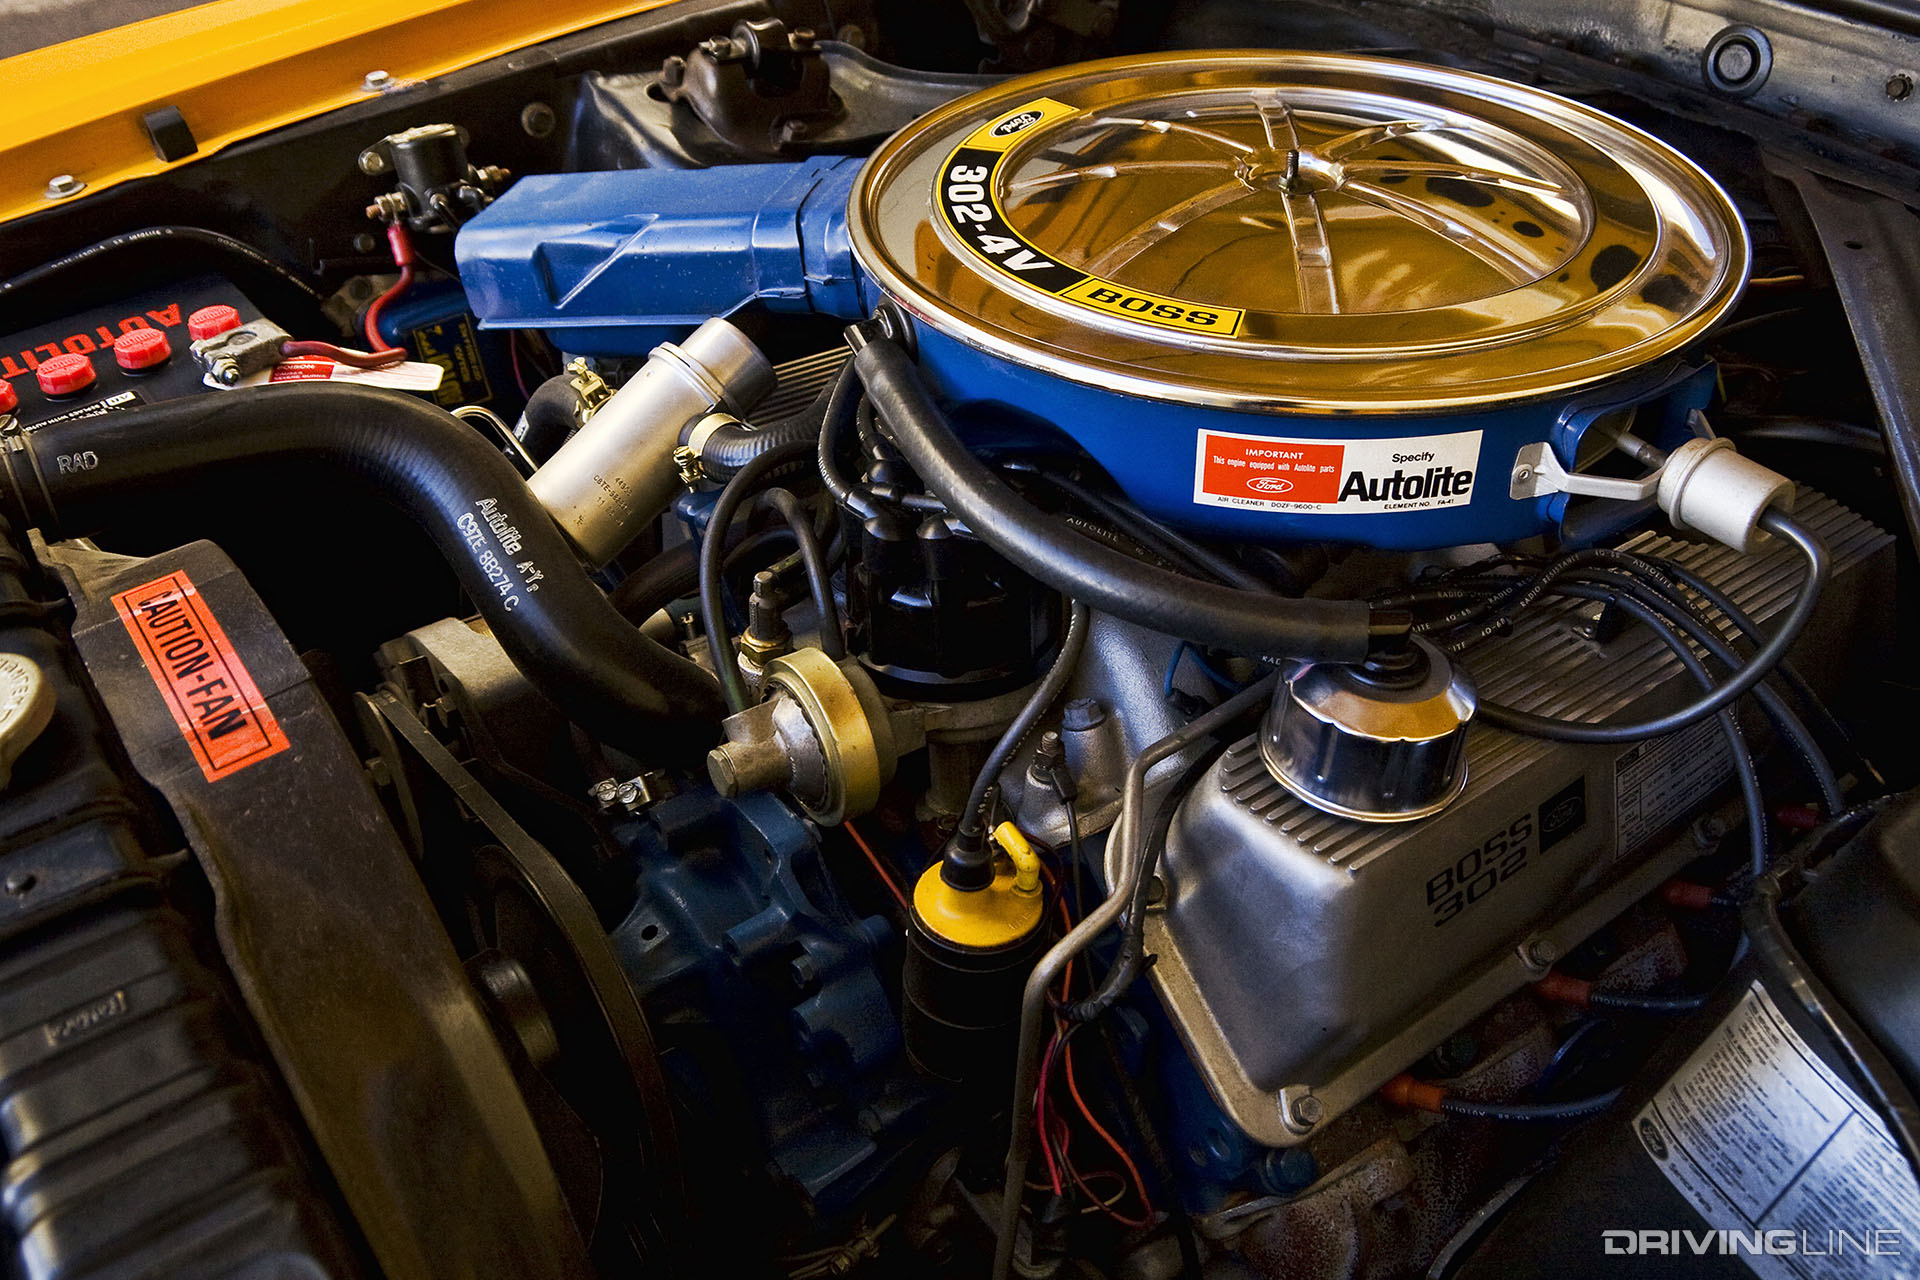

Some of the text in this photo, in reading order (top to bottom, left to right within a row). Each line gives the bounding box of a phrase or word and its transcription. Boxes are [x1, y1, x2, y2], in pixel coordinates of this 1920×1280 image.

[949, 165, 1055, 272] 302-4V
[1086, 287, 1219, 327] BOSS
[56, 450, 99, 475] RAD
[1213, 455, 1335, 473] This engine equipped with Autolite parts
[1245, 448, 1304, 460] IMPORTANT
[1391, 452, 1435, 464] Specify
[1255, 478, 1286, 492] Ford
[1338, 466, 1473, 502] Autolite
[1232, 497, 1265, 507] CLEANER
[1384, 502, 1418, 510] ELEMENT
[475, 498, 523, 556] Autolite
[1066, 517, 1119, 543] AUTOLITE
[456, 512, 520, 612] C9ZE 8B274 C
[1519, 585, 1542, 609] RADIO
[1632, 558, 1673, 589] AUTOLITE
[1426, 812, 1532, 906] BOSS
[1433, 846, 1528, 928] 302
